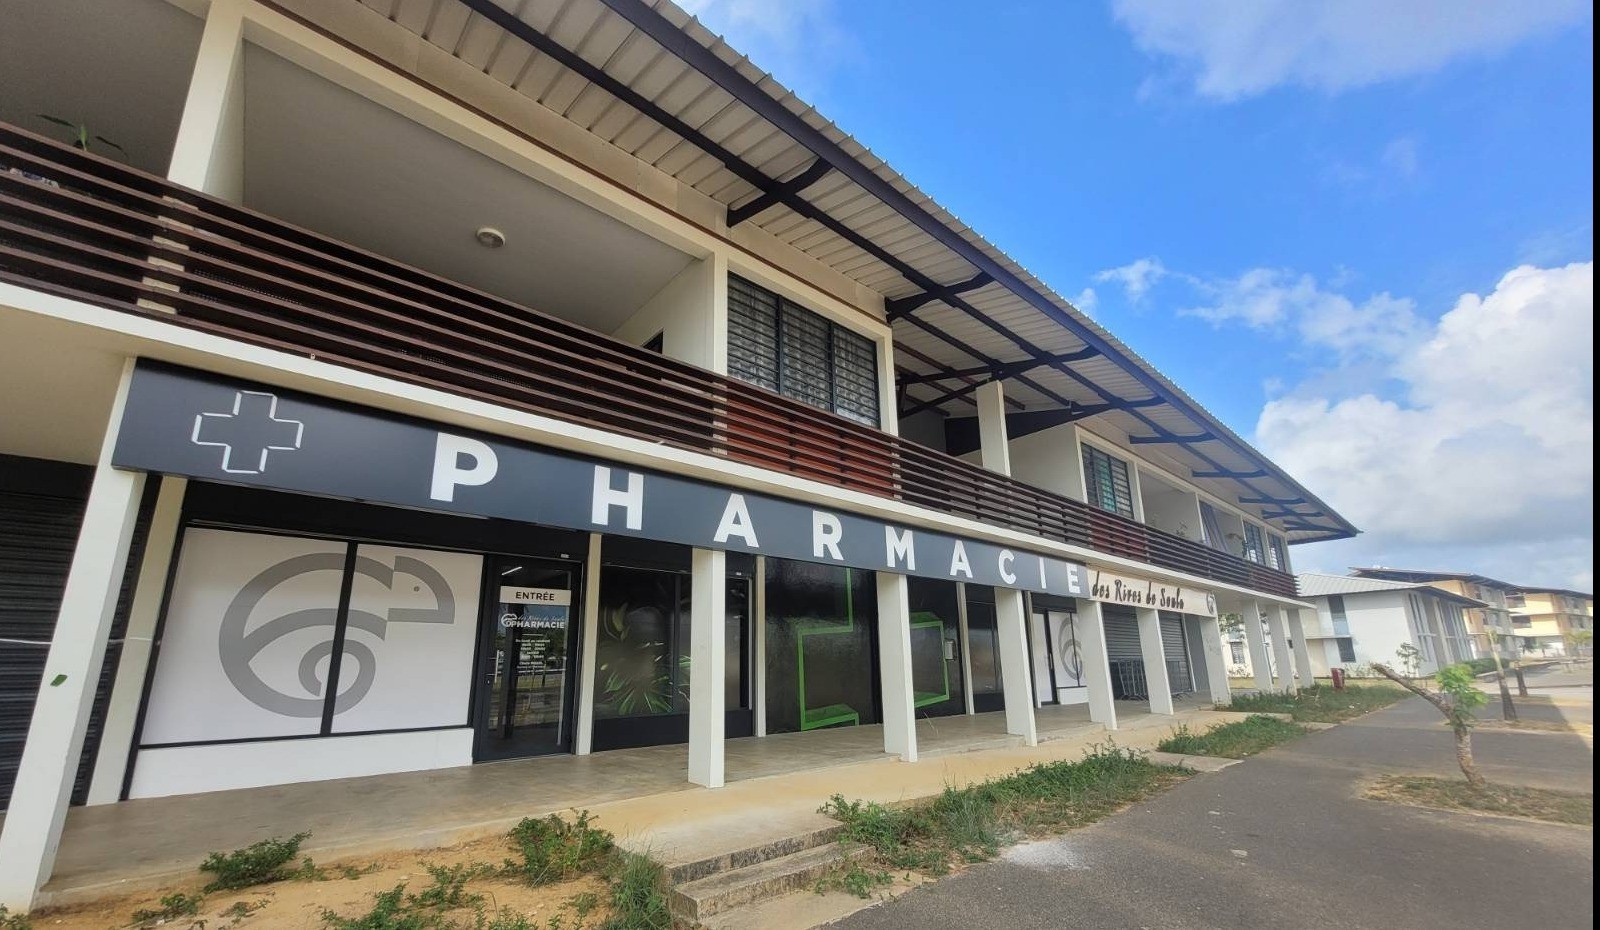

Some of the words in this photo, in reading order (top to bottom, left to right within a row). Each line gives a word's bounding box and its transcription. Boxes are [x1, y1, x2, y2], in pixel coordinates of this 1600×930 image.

[430, 432, 1081, 594] PHARMACIE
[515, 591, 555, 601] ENTRÉE
[1092, 570, 1110, 599] des
[1115, 579, 1142, 604] Rives
[1145, 581, 1156, 605] de
[511, 620, 565, 629] PHARMACIE
